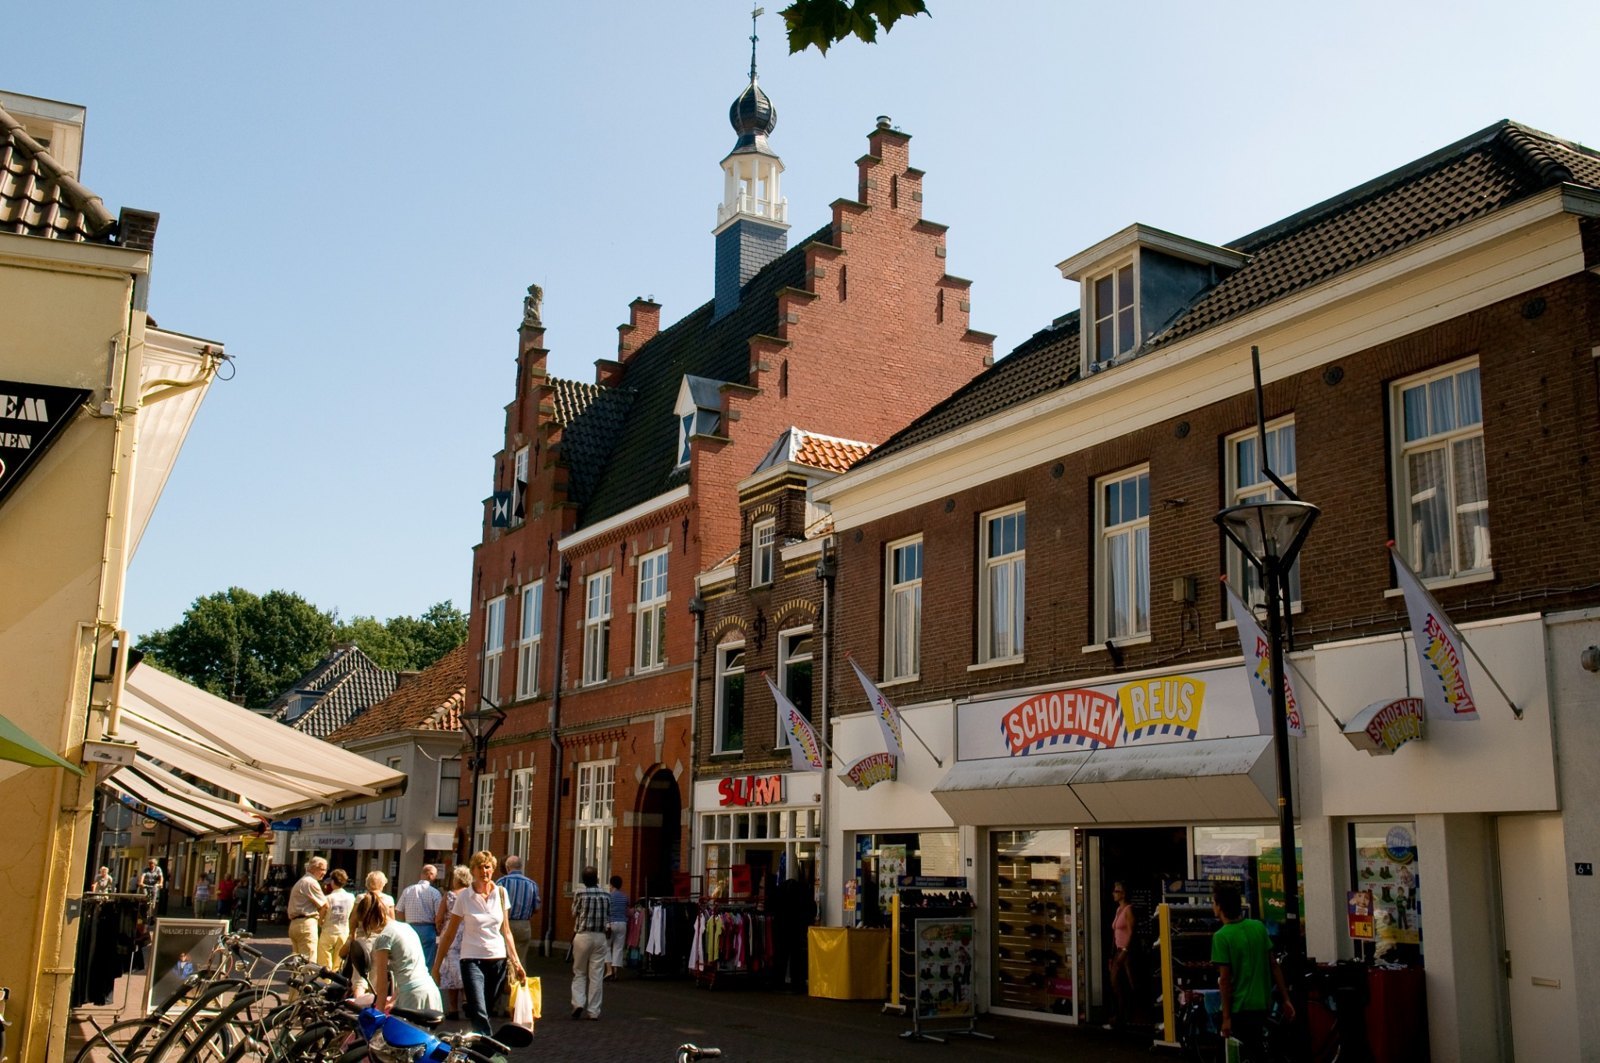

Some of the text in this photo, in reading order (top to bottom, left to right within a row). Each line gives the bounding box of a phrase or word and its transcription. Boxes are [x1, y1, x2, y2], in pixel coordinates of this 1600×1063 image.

[1429, 617, 1473, 712] SCHOENEN
[1007, 680, 1196, 748] SCHOENEN REUS
[1367, 698, 1423, 741] SCHOENEN
[1388, 718, 1415, 744] REUS
[849, 753, 895, 783] SCHOENEN
[865, 767, 887, 783] REUS
[718, 774, 782, 807] SLIM
[318, 837, 346, 845] BABYSHOP
